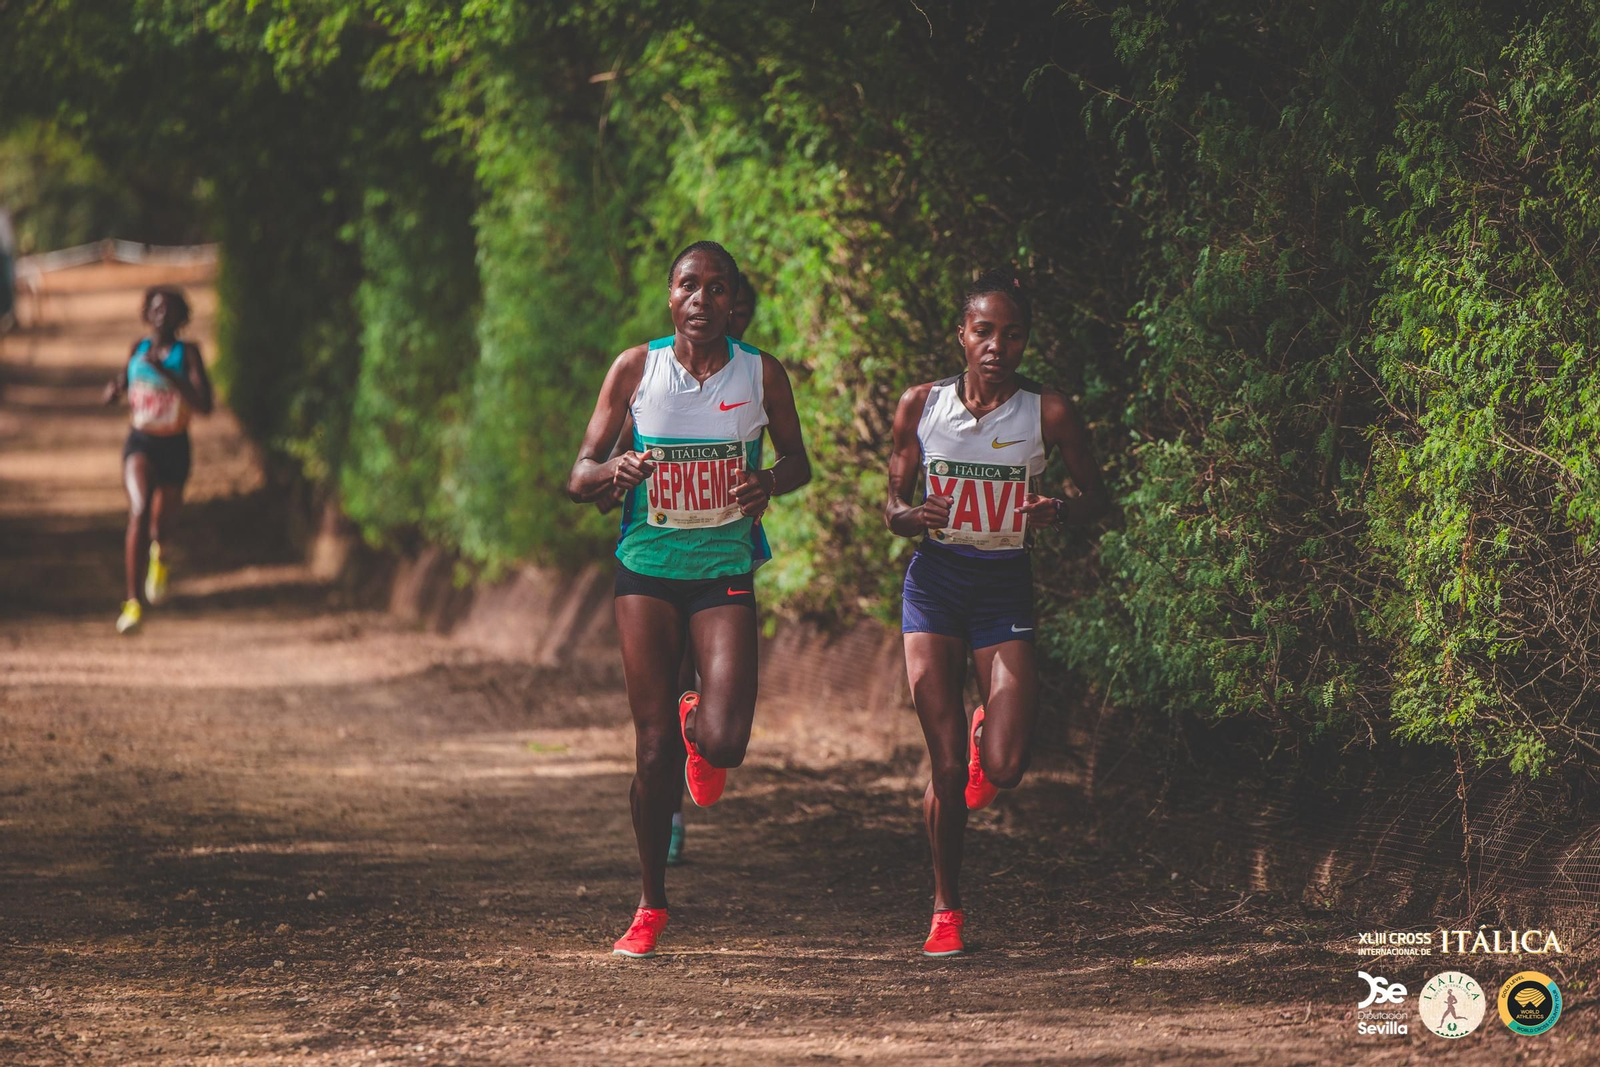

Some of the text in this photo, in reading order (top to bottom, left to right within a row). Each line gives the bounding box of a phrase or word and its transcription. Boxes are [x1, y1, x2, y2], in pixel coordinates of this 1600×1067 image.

[672, 447, 718, 459] ITÁLICA
[955, 464, 1001, 477] ITÁLICA
[649, 457, 743, 511] JEPKEME
